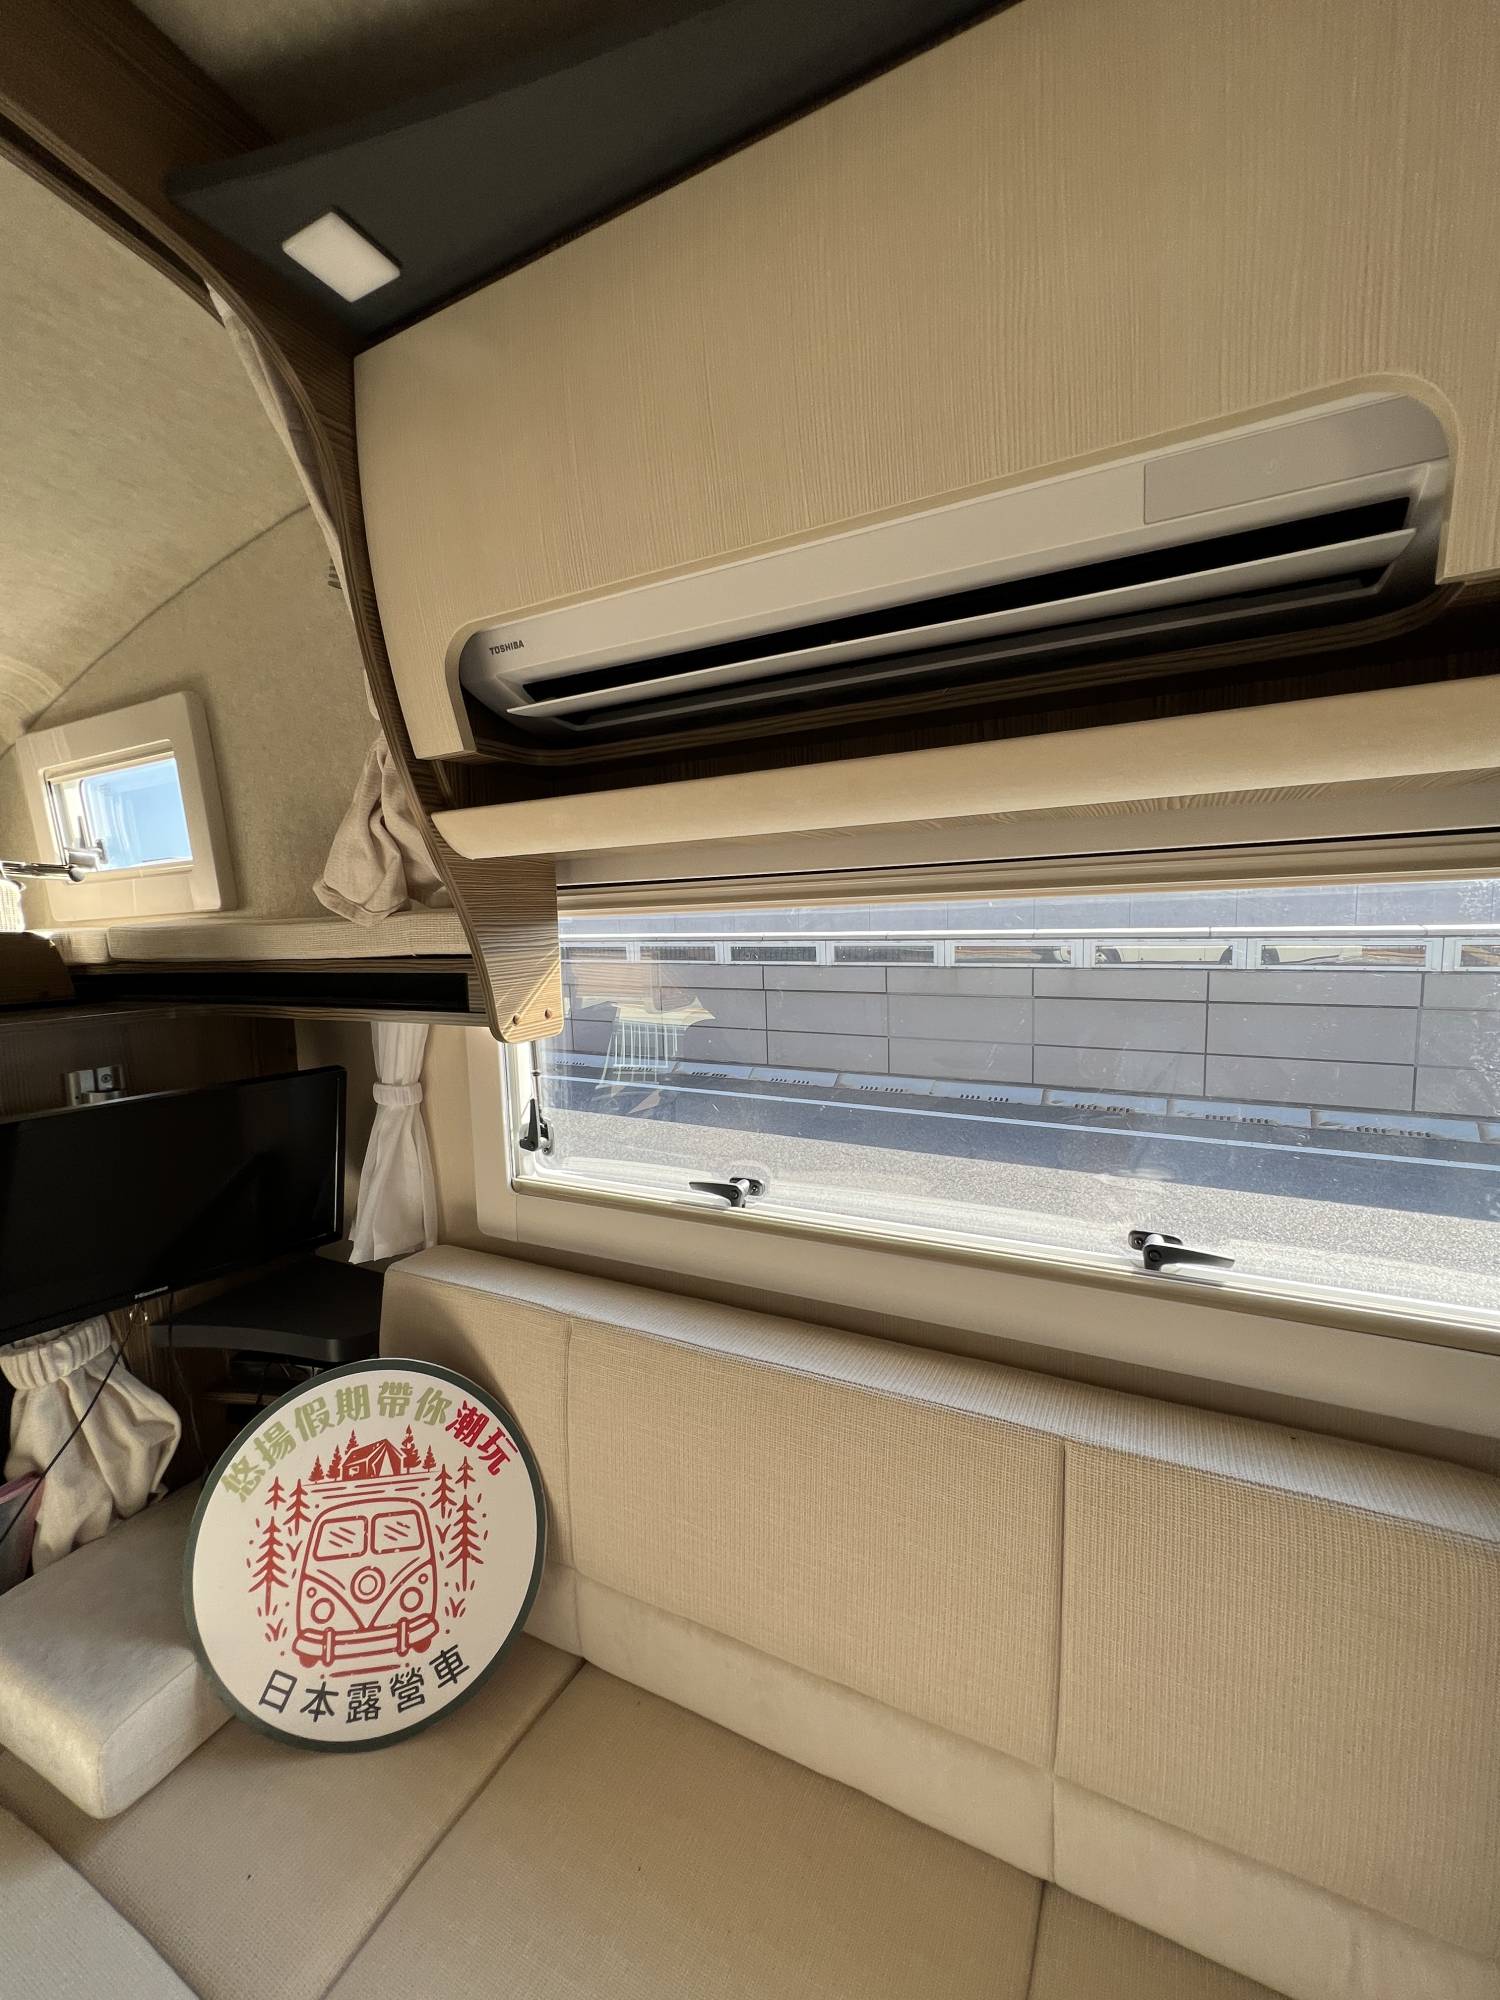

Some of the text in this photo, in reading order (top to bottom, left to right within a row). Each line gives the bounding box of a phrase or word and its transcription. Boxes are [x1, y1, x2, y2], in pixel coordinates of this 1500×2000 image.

[489, 640, 524, 655] TOSHIBA
[259, 1644, 470, 1723] 日本露營車
